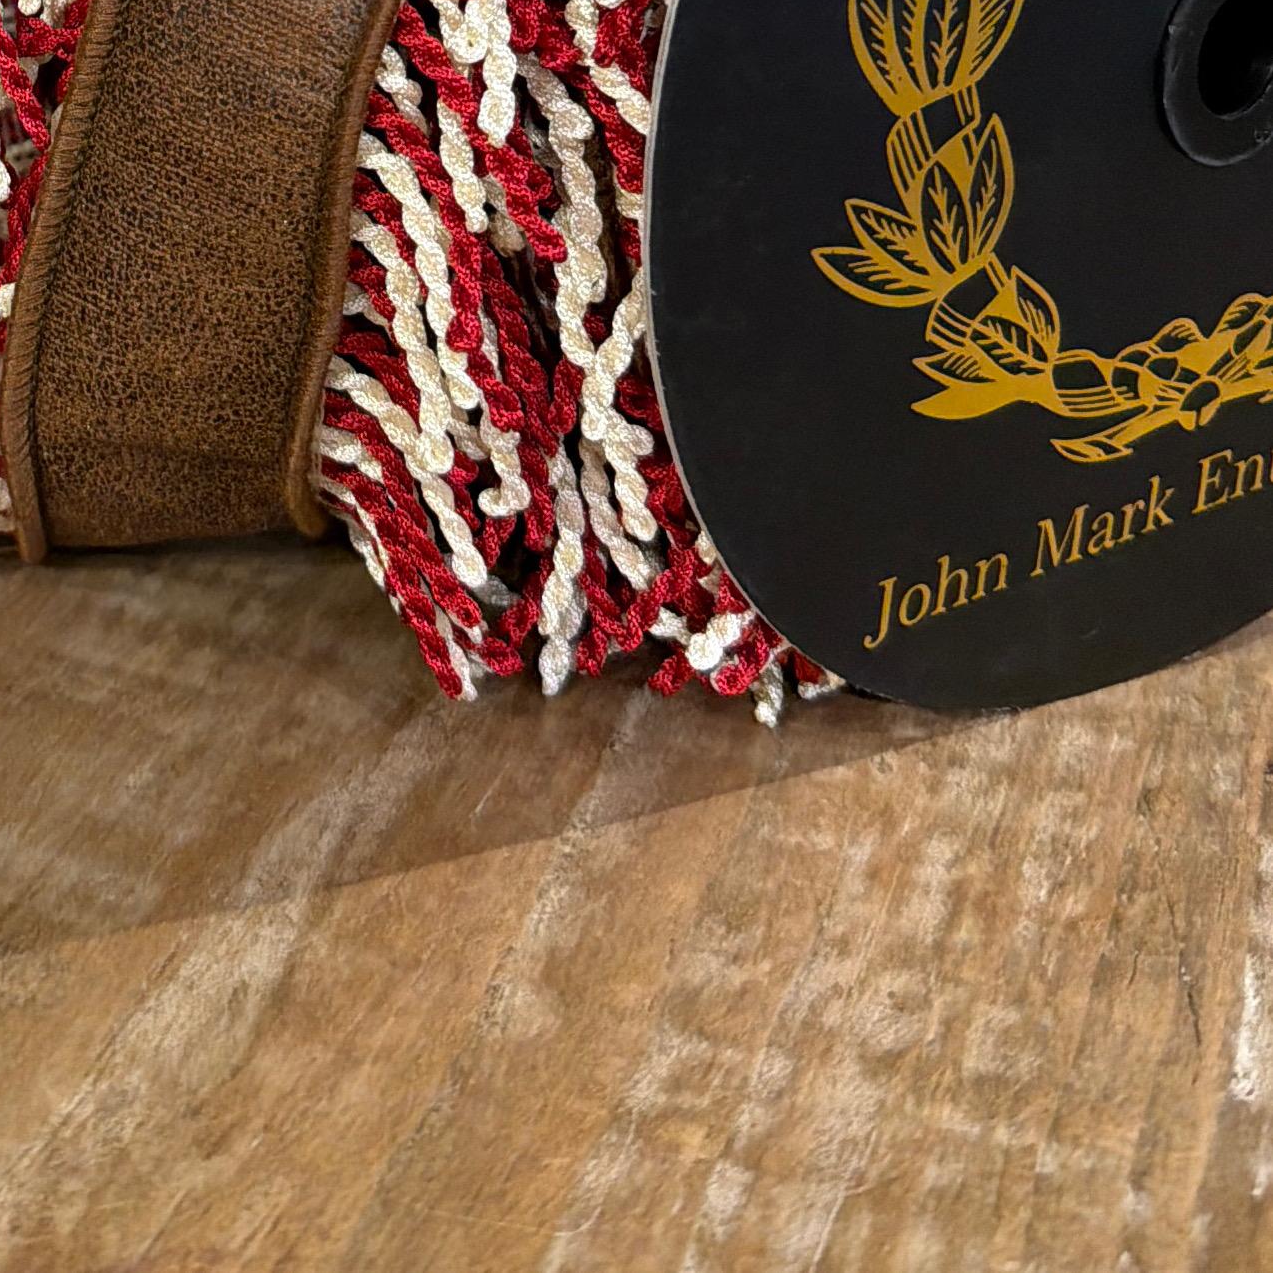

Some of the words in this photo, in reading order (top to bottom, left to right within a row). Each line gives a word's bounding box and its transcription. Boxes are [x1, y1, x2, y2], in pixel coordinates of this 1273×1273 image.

[863, 553, 1009, 649] John
[1030, 475, 1174, 577] Mark
[1191, 448, 1273, 514] En
